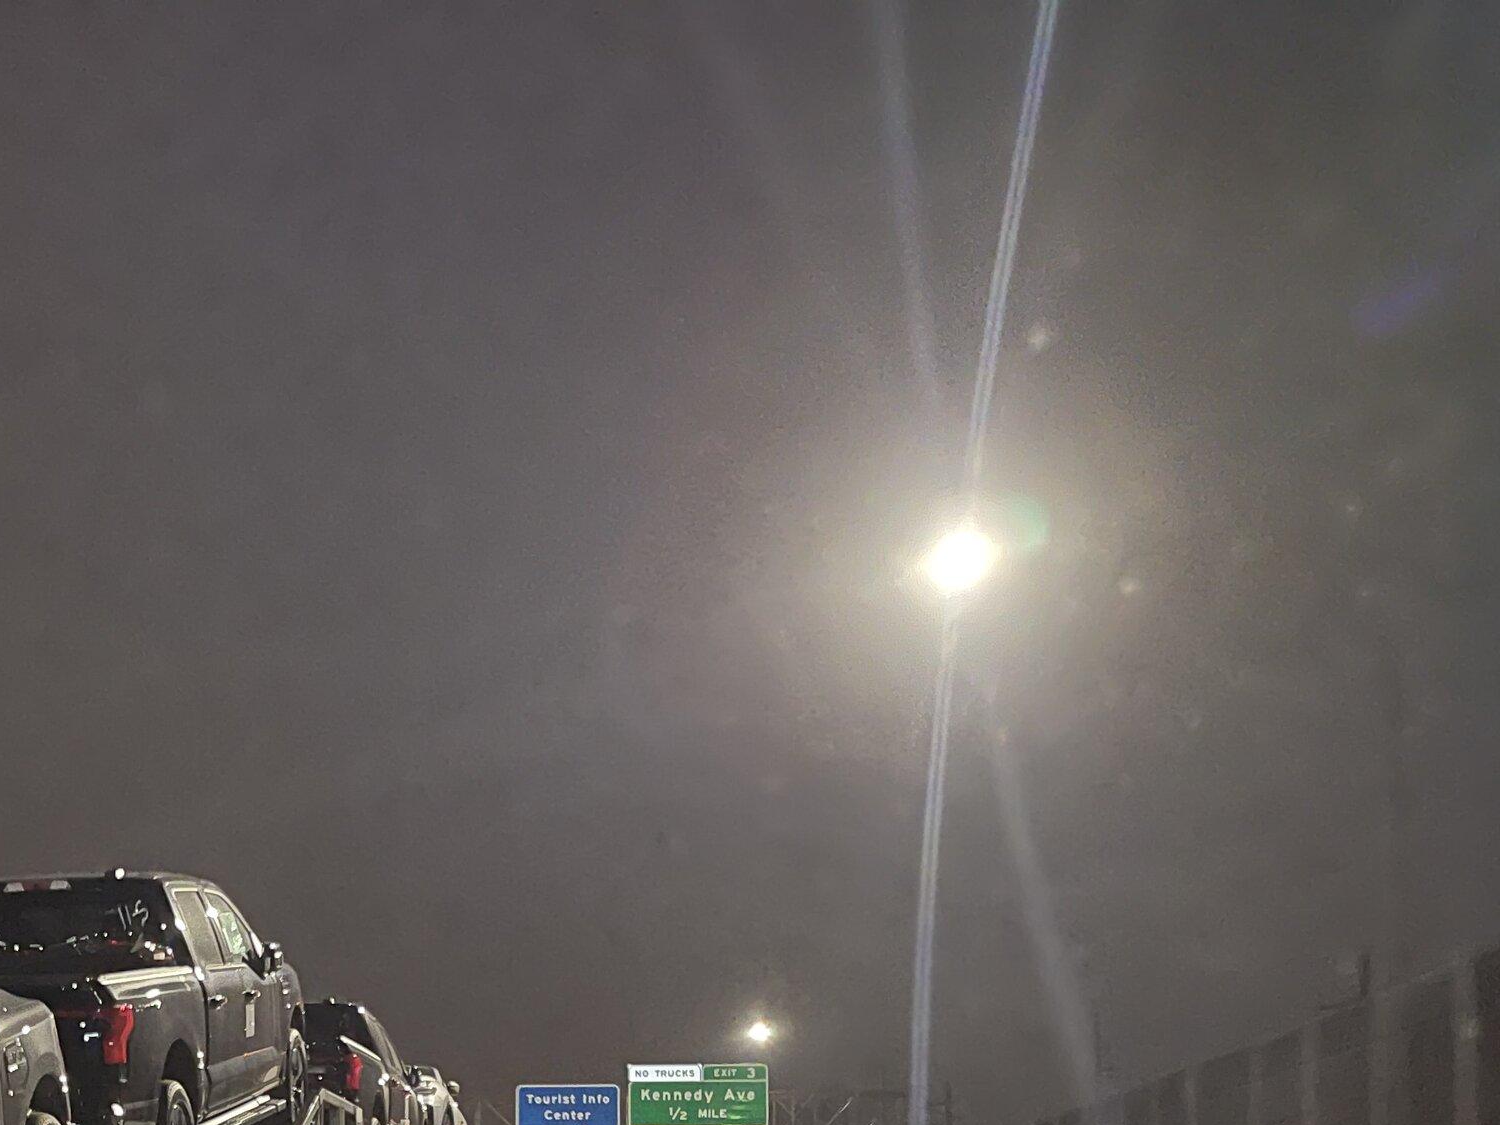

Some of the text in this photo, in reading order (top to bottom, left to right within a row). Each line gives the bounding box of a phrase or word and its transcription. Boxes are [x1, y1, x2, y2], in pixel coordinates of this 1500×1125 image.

[635, 1069, 695, 1078] NO TRUCKS
[713, 1067, 756, 1078] EXIT 3
[525, 1093, 610, 1105] Tourist Info
[641, 1088, 756, 1104] Kennedy Ave
[544, 1110, 591, 1121] Center
[698, 1108, 728, 1119] MILE
